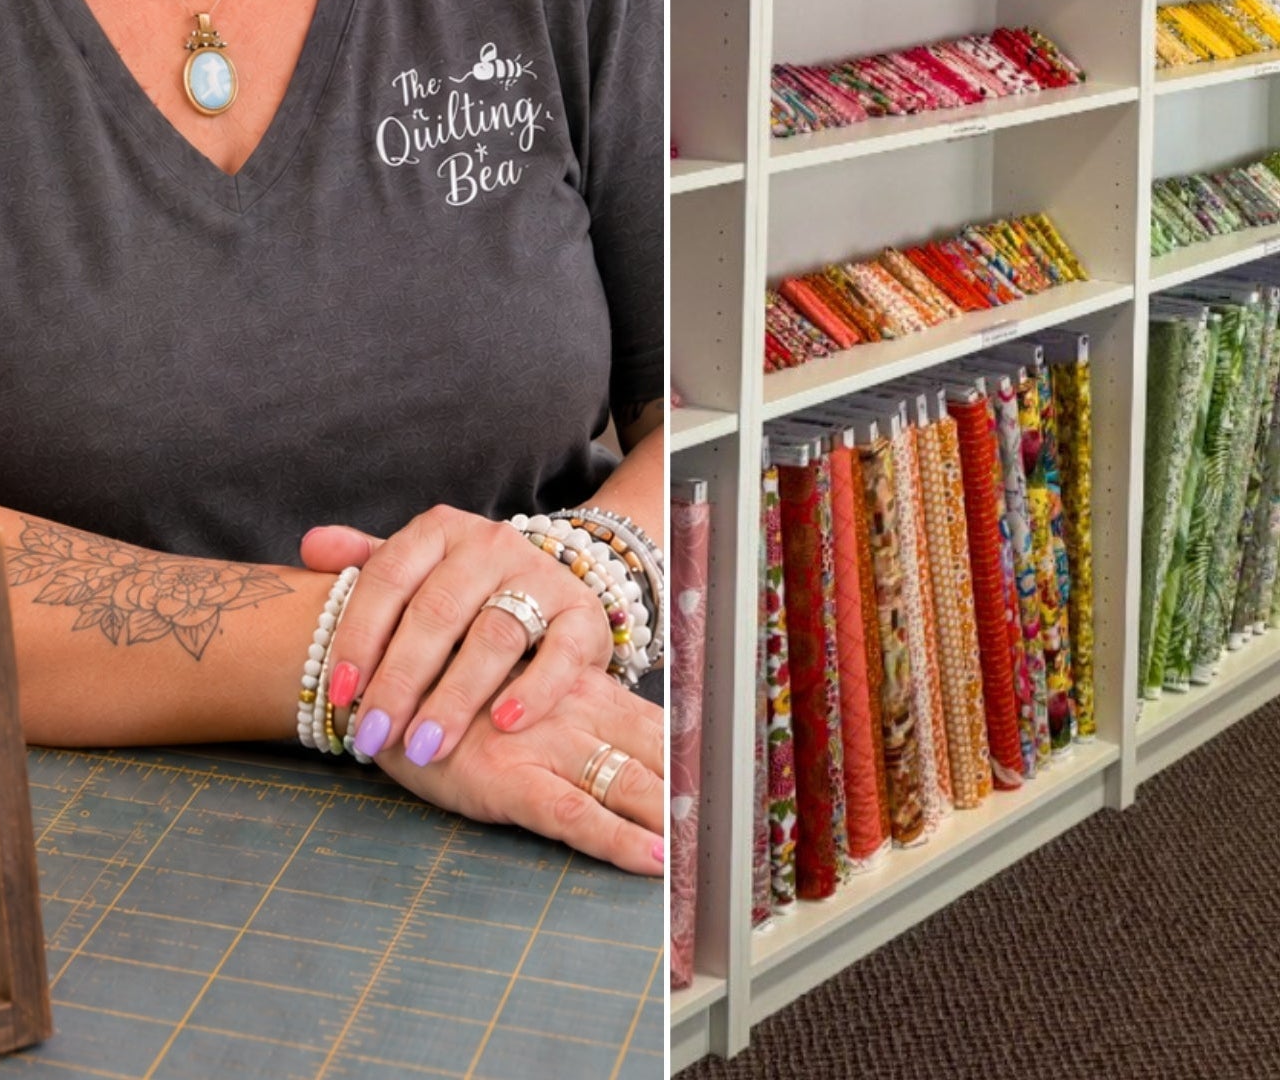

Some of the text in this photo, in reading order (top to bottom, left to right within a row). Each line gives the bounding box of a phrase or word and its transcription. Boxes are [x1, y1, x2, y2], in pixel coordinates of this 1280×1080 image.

[392, 69, 441, 106] The
[376, 90, 545, 167] Quilting
[437, 152, 523, 206] Bea
